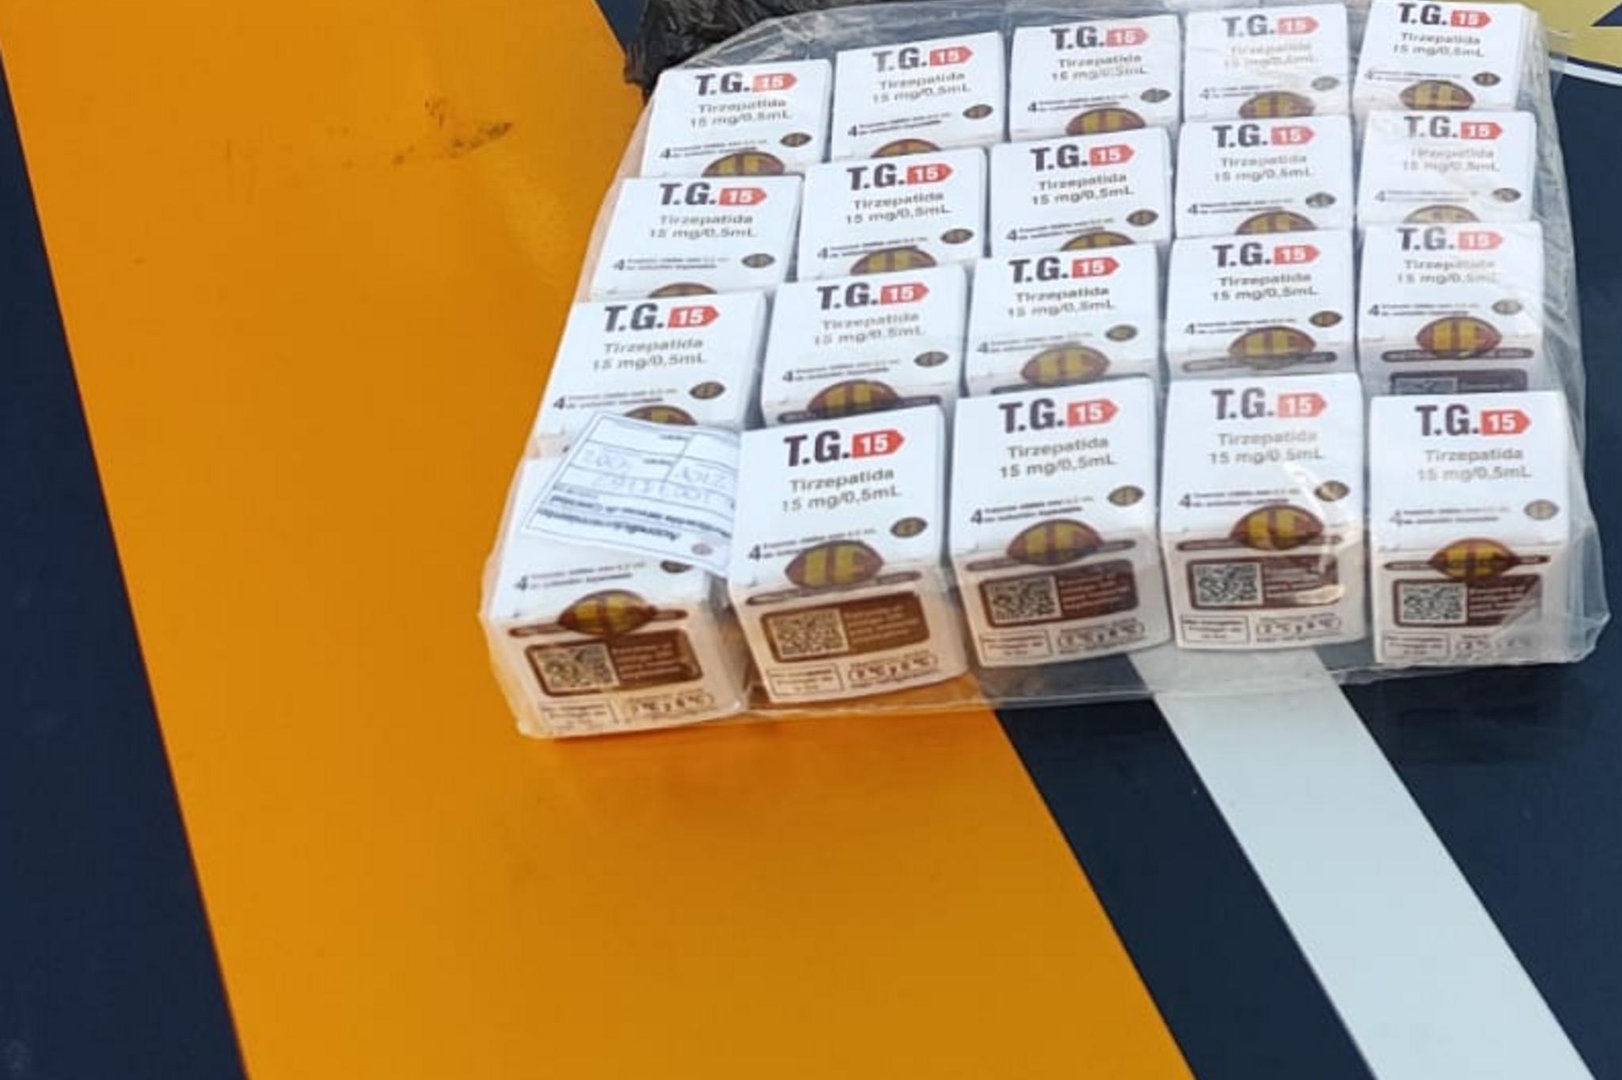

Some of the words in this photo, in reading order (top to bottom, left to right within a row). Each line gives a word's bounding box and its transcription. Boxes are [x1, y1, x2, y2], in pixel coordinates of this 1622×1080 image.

[1212, 124, 1267, 148] T.G.
[1281, 127, 1298, 143] 15
[1030, 144, 1088, 172] T.G.
[1100, 147, 1118, 161] 15
[845, 163, 906, 191] T.G.
[916, 165, 939, 182] 15
[659, 182, 717, 206] T.G.
[730, 189, 753, 205] 15
[1212, 242, 1271, 268] T.G.
[1284, 246, 1306, 262] 15
[1008, 256, 1069, 284] T.G.
[1080, 259, 1105, 276] 15
[817, 283, 878, 310] T.G.
[889, 285, 914, 302] 15
[604, 303, 664, 332] T.G.
[679, 307, 703, 326] 15
[998, 399, 1064, 433] T.G.
[1075, 401, 1102, 423] 15
[1211, 388, 1274, 420] T.G.
[1286, 395, 1312, 415] 15
[1415, 404, 1479, 436] T.G.
[1488, 412, 1517, 431] 15
[784, 430, 850, 467] T.G.
[861, 432, 888, 454] 15
